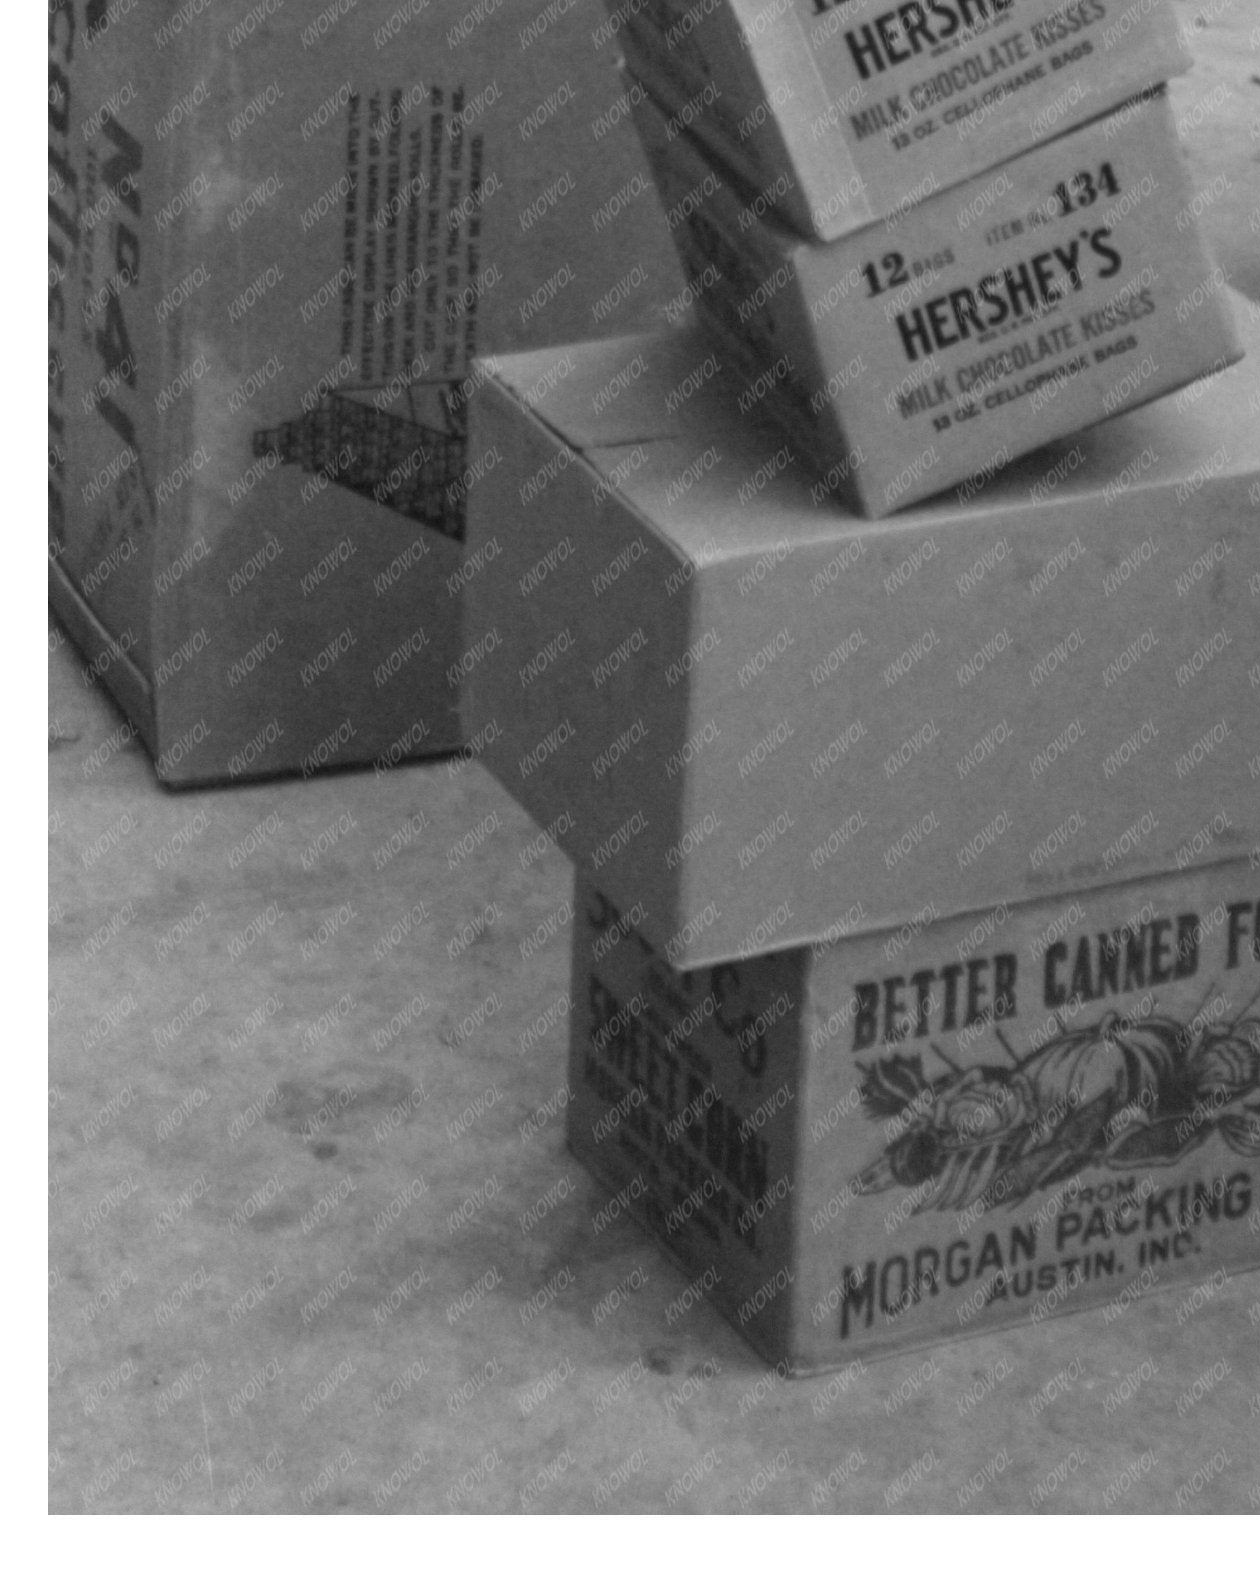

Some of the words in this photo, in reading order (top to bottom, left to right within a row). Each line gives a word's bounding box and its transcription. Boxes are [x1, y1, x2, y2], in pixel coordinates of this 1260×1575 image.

[850, 95, 909, 142] MILK
[908, 33, 1031, 112] CHOCOLATE
[942, 64, 1047, 126] CELLOPHANE
[1050, 40, 1094, 71] BAGS
[861, 251, 911, 299] 12
[913, 249, 956, 278] BAGS
[1052, 161, 1121, 218] 134
[895, 227, 1122, 363] HERSHEY'S
[898, 375, 952, 420] MILK
[956, 324, 1077, 394] CHOCOLATE
[1079, 289, 1156, 342] KISSES
[984, 354, 1091, 411] CELLOPHANE
[1093, 334, 1138, 363] BAGS
[853, 953, 1018, 1052] BETTER
[1044, 912, 1199, 1010] CANNED
[840, 1222, 1037, 1340] MORGAN
[1056, 1172, 1252, 1252] PACKING
[1062, 1176, 1136, 1209] FROM
